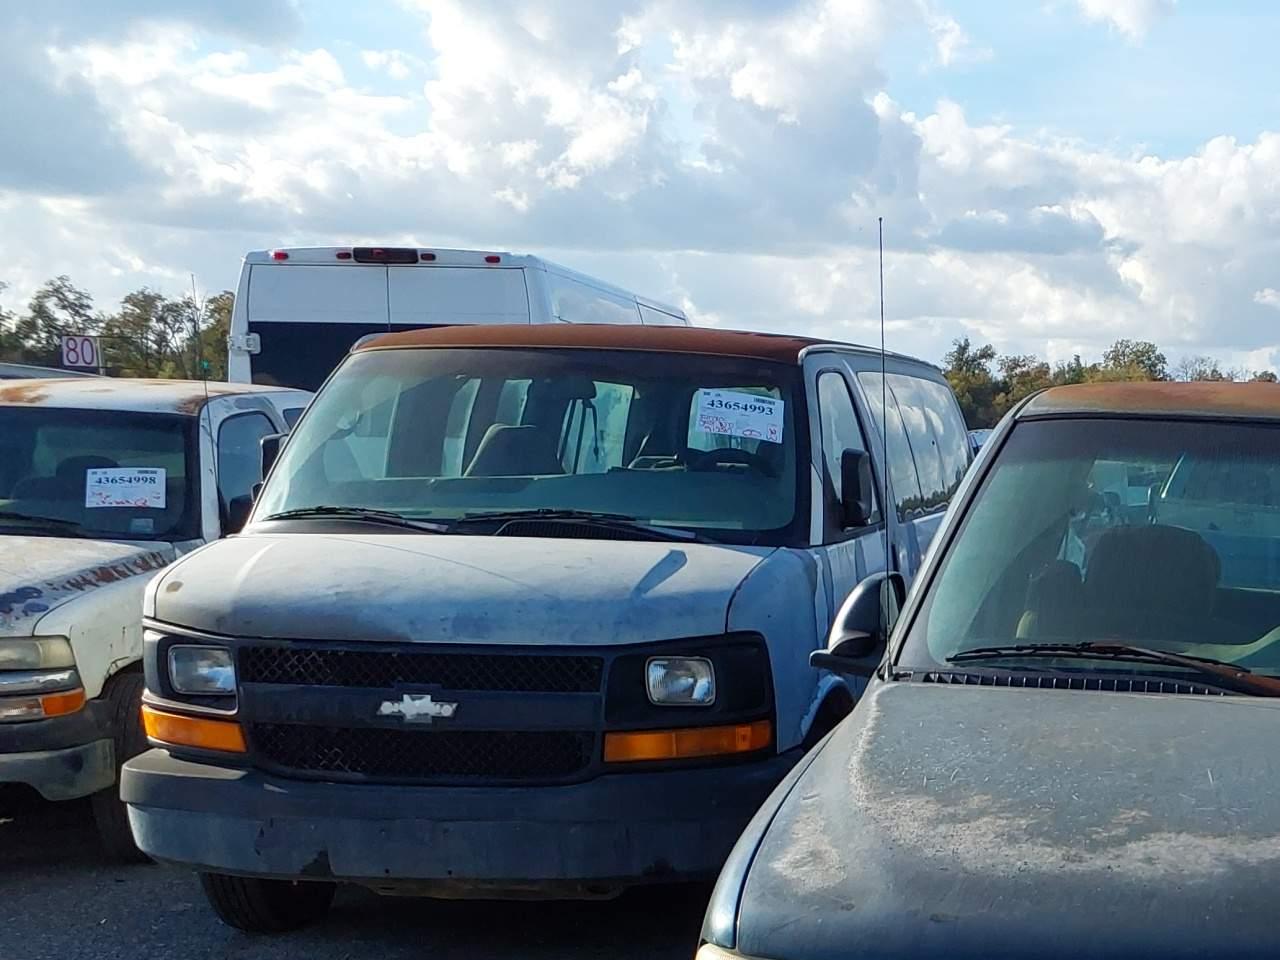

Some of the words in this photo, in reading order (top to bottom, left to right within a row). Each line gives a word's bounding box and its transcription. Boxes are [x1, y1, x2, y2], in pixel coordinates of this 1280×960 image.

[66, 337, 95, 365] 80
[707, 399, 774, 416] 43654993
[95, 476, 157, 485] 43654998
